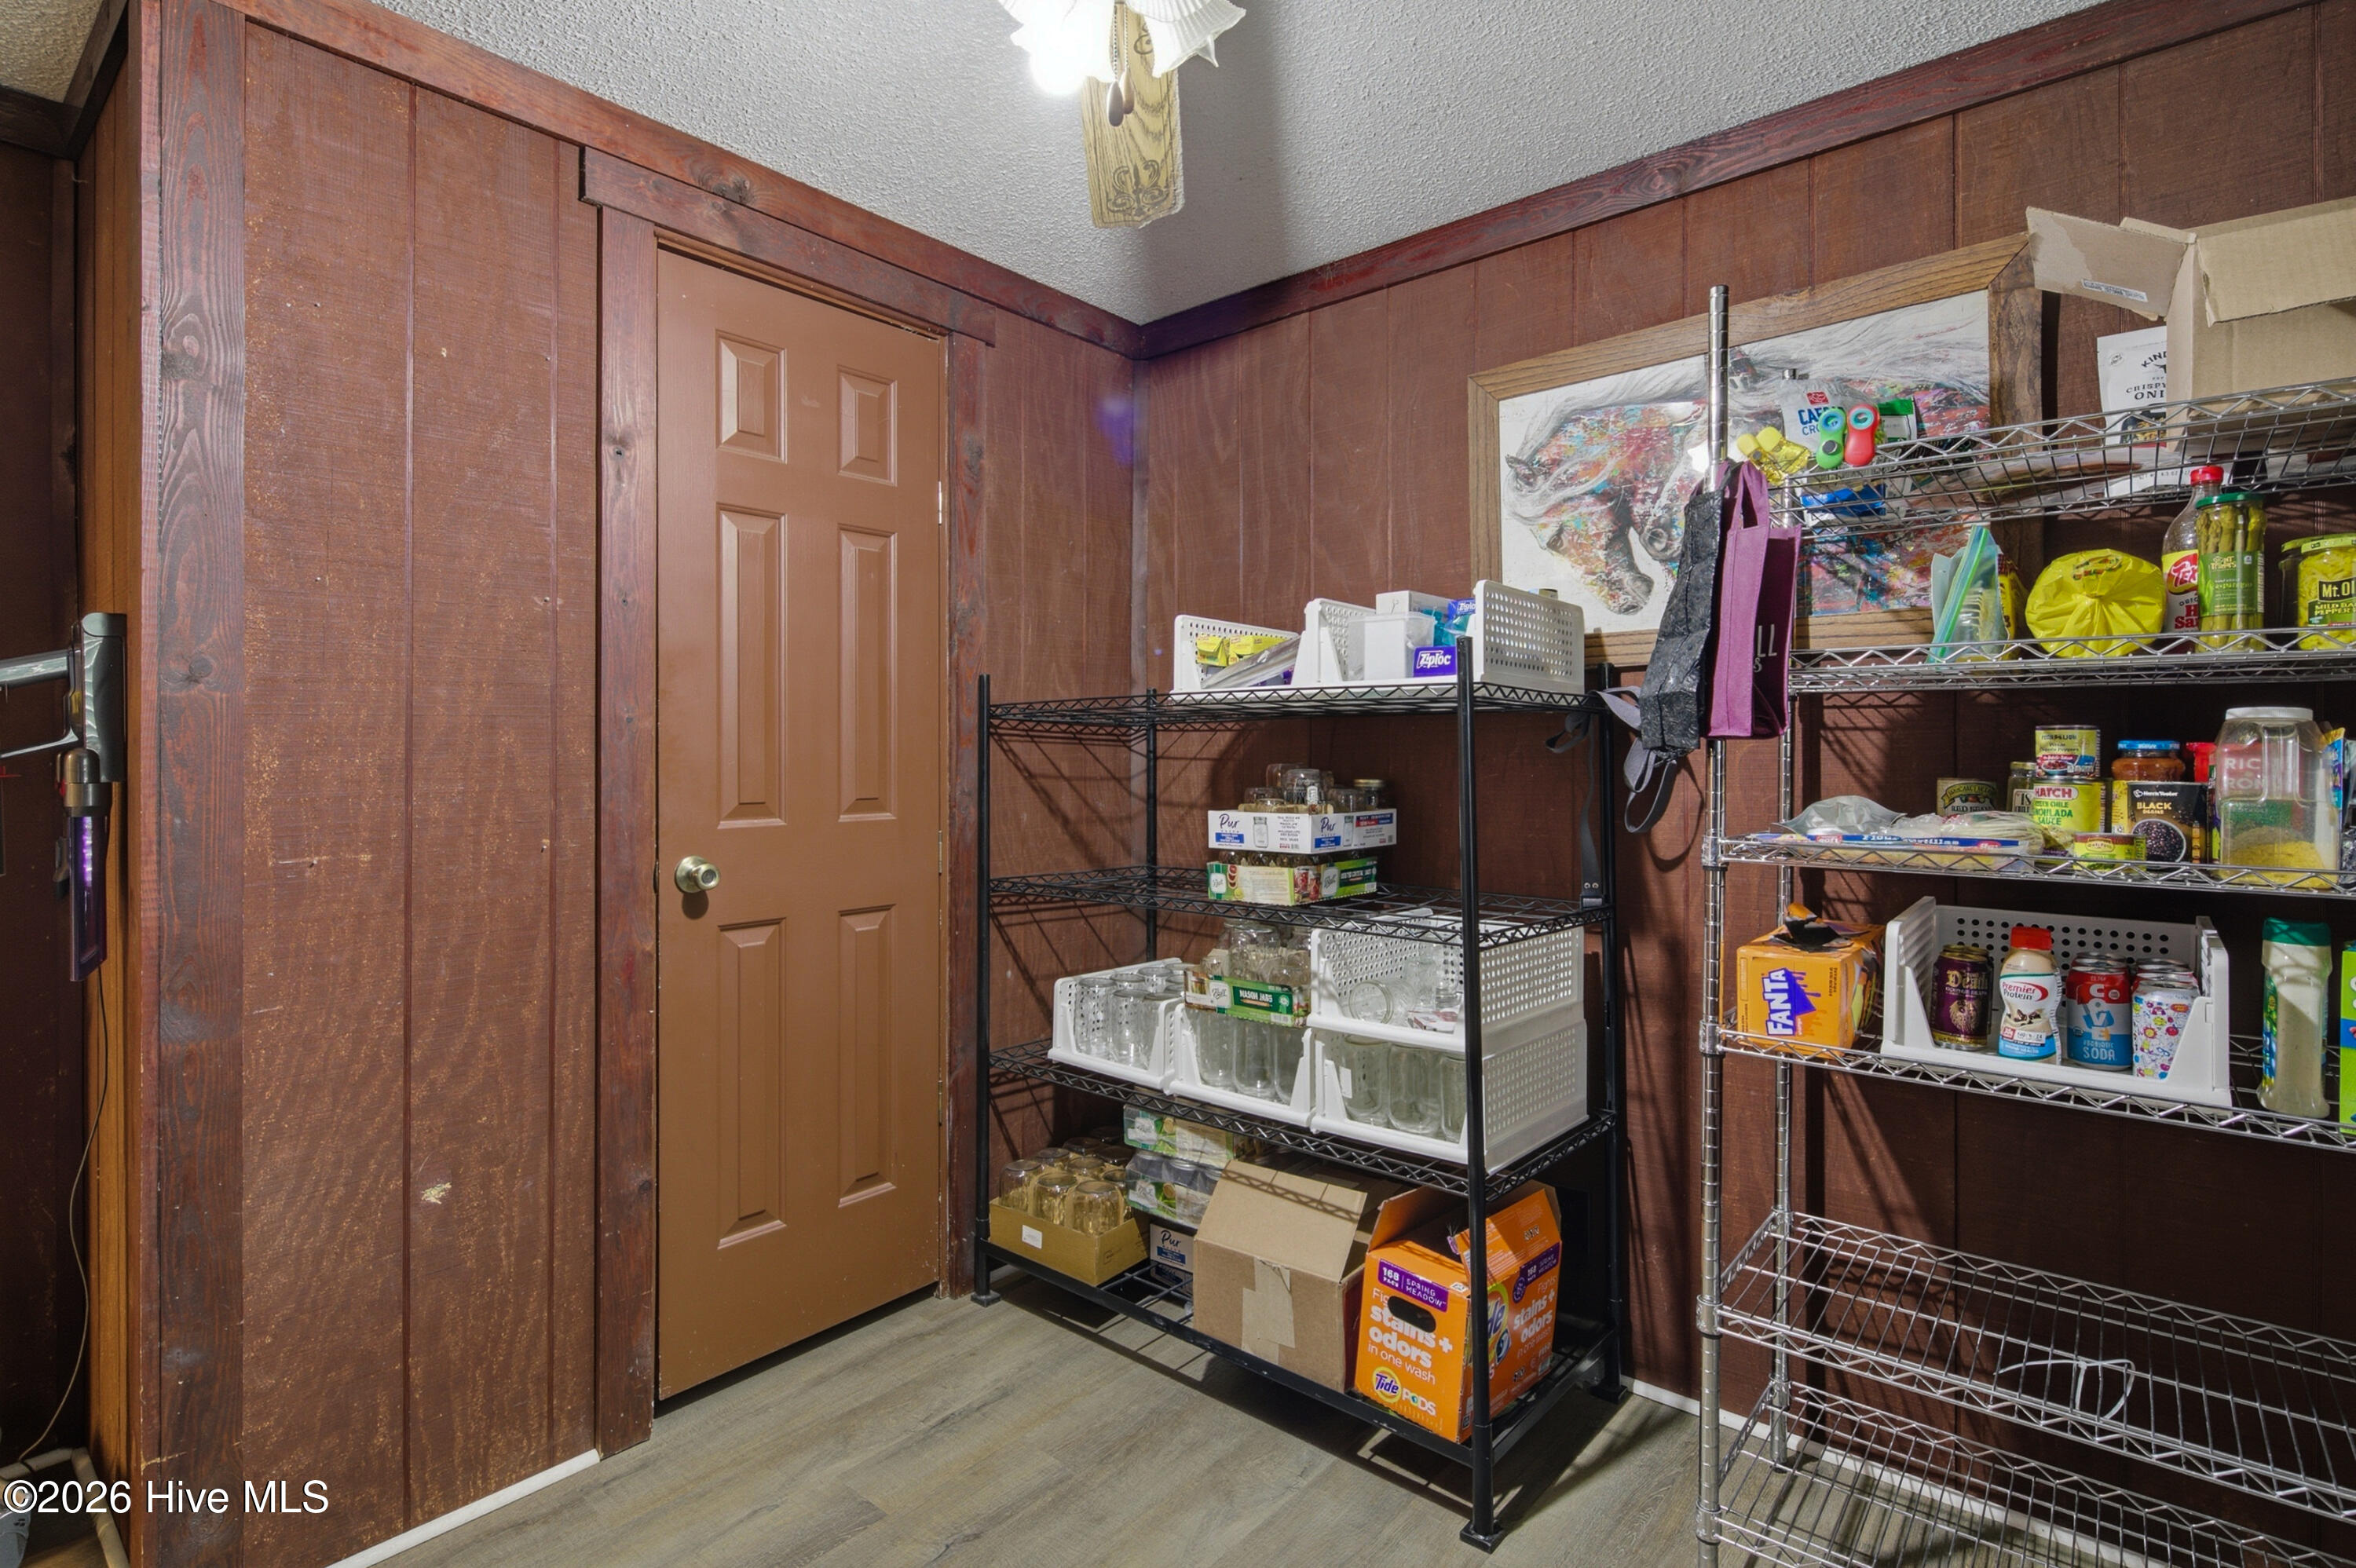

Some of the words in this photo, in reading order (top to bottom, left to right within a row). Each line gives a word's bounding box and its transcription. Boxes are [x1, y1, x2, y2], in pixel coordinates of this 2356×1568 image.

[1417, 650, 1452, 669] Ziploc
[2035, 787, 2072, 799] HATCH
[2137, 802, 2172, 810] BLACK
[1219, 813, 1240, 829] Pur
[1321, 817, 1336, 832] Pur
[2002, 981, 2036, 994] Premier
[2003, 989, 2032, 1000] Protein
[1764, 969, 1794, 1036] FANTA
[2083, 1046, 2115, 1061] SODA
[1382, 1266, 1399, 1281] 168
[1406, 1278, 1436, 1297] SPRING
[1513, 1295, 1547, 1331] stains
[1520, 1309, 1553, 1343] odors
[1369, 1326, 1432, 1369] odors
[1367, 1340, 1378, 1356] in
[1380, 1350, 1403, 1368] one
[1404, 1361, 1436, 1385] wash
[1375, 1372, 1399, 1394] Tide
[1402, 1387, 1437, 1417] PODS
